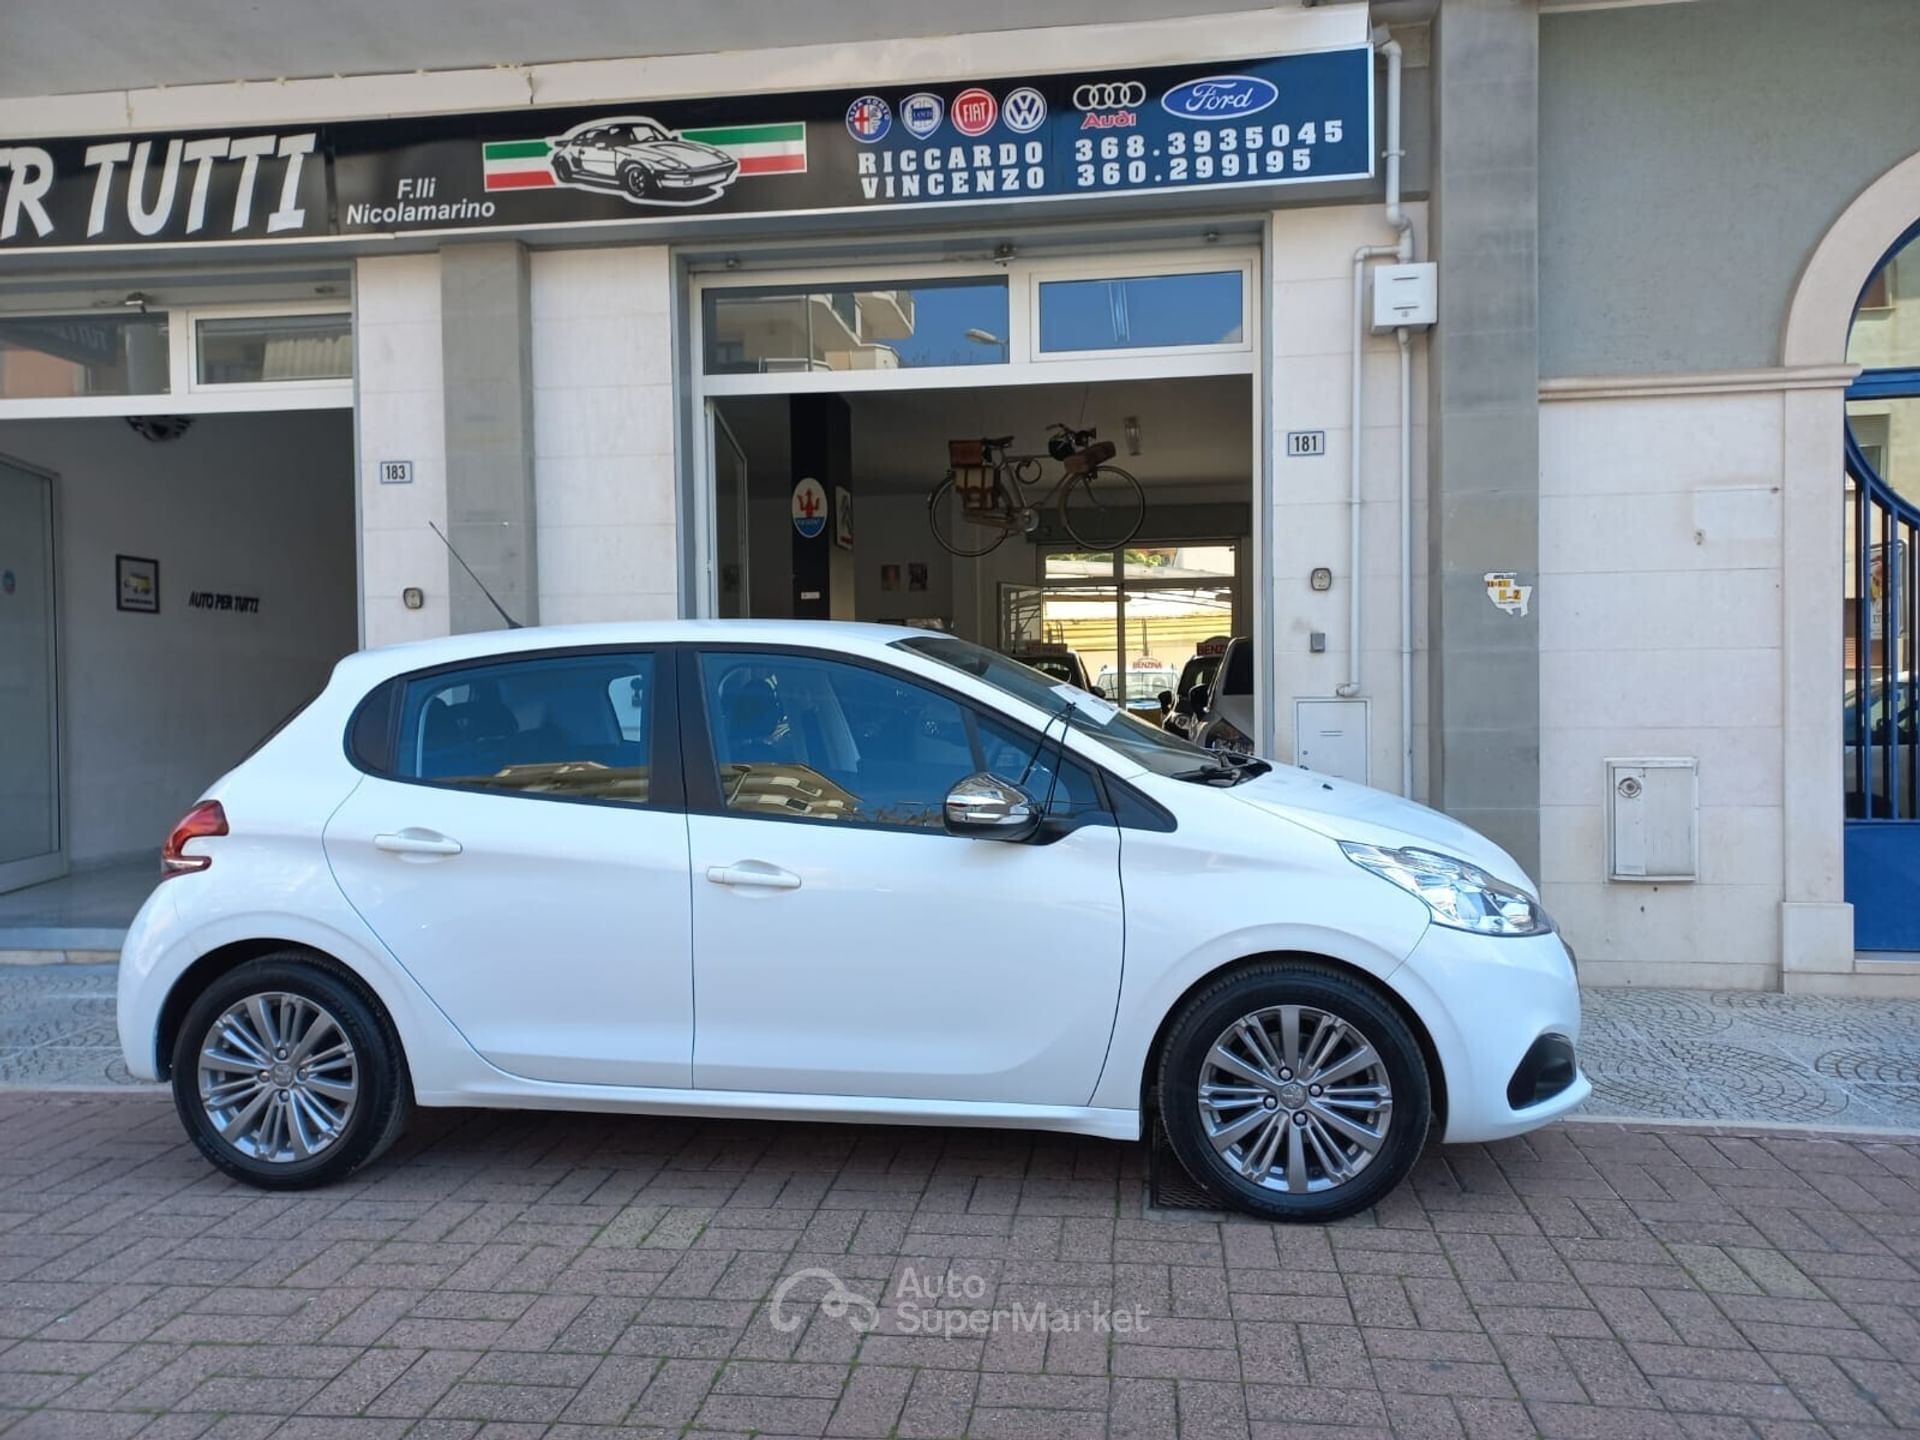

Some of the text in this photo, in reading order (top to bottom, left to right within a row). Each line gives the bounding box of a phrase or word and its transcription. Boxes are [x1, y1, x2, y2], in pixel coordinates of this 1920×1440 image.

[1185, 81, 1253, 111] Ford
[963, 102, 987, 123] FIAT
[1080, 110, 1137, 129] Audi
[1075, 120, 1343, 161] 368.3935045
[857, 141, 1043, 174] RICCARDO
[1077, 148, 1312, 186] 360.299195
[84, 132, 316, 238] TUTTI
[397, 177, 436, 199] F.lli
[860, 166, 1045, 199] VINCENZO
[346, 198, 495, 225] Nicolamarino
[1295, 435, 1316, 453] 181
[386, 464, 406, 480] 183
[189, 591, 214, 609] AUTO
[215, 593, 233, 611] PER
